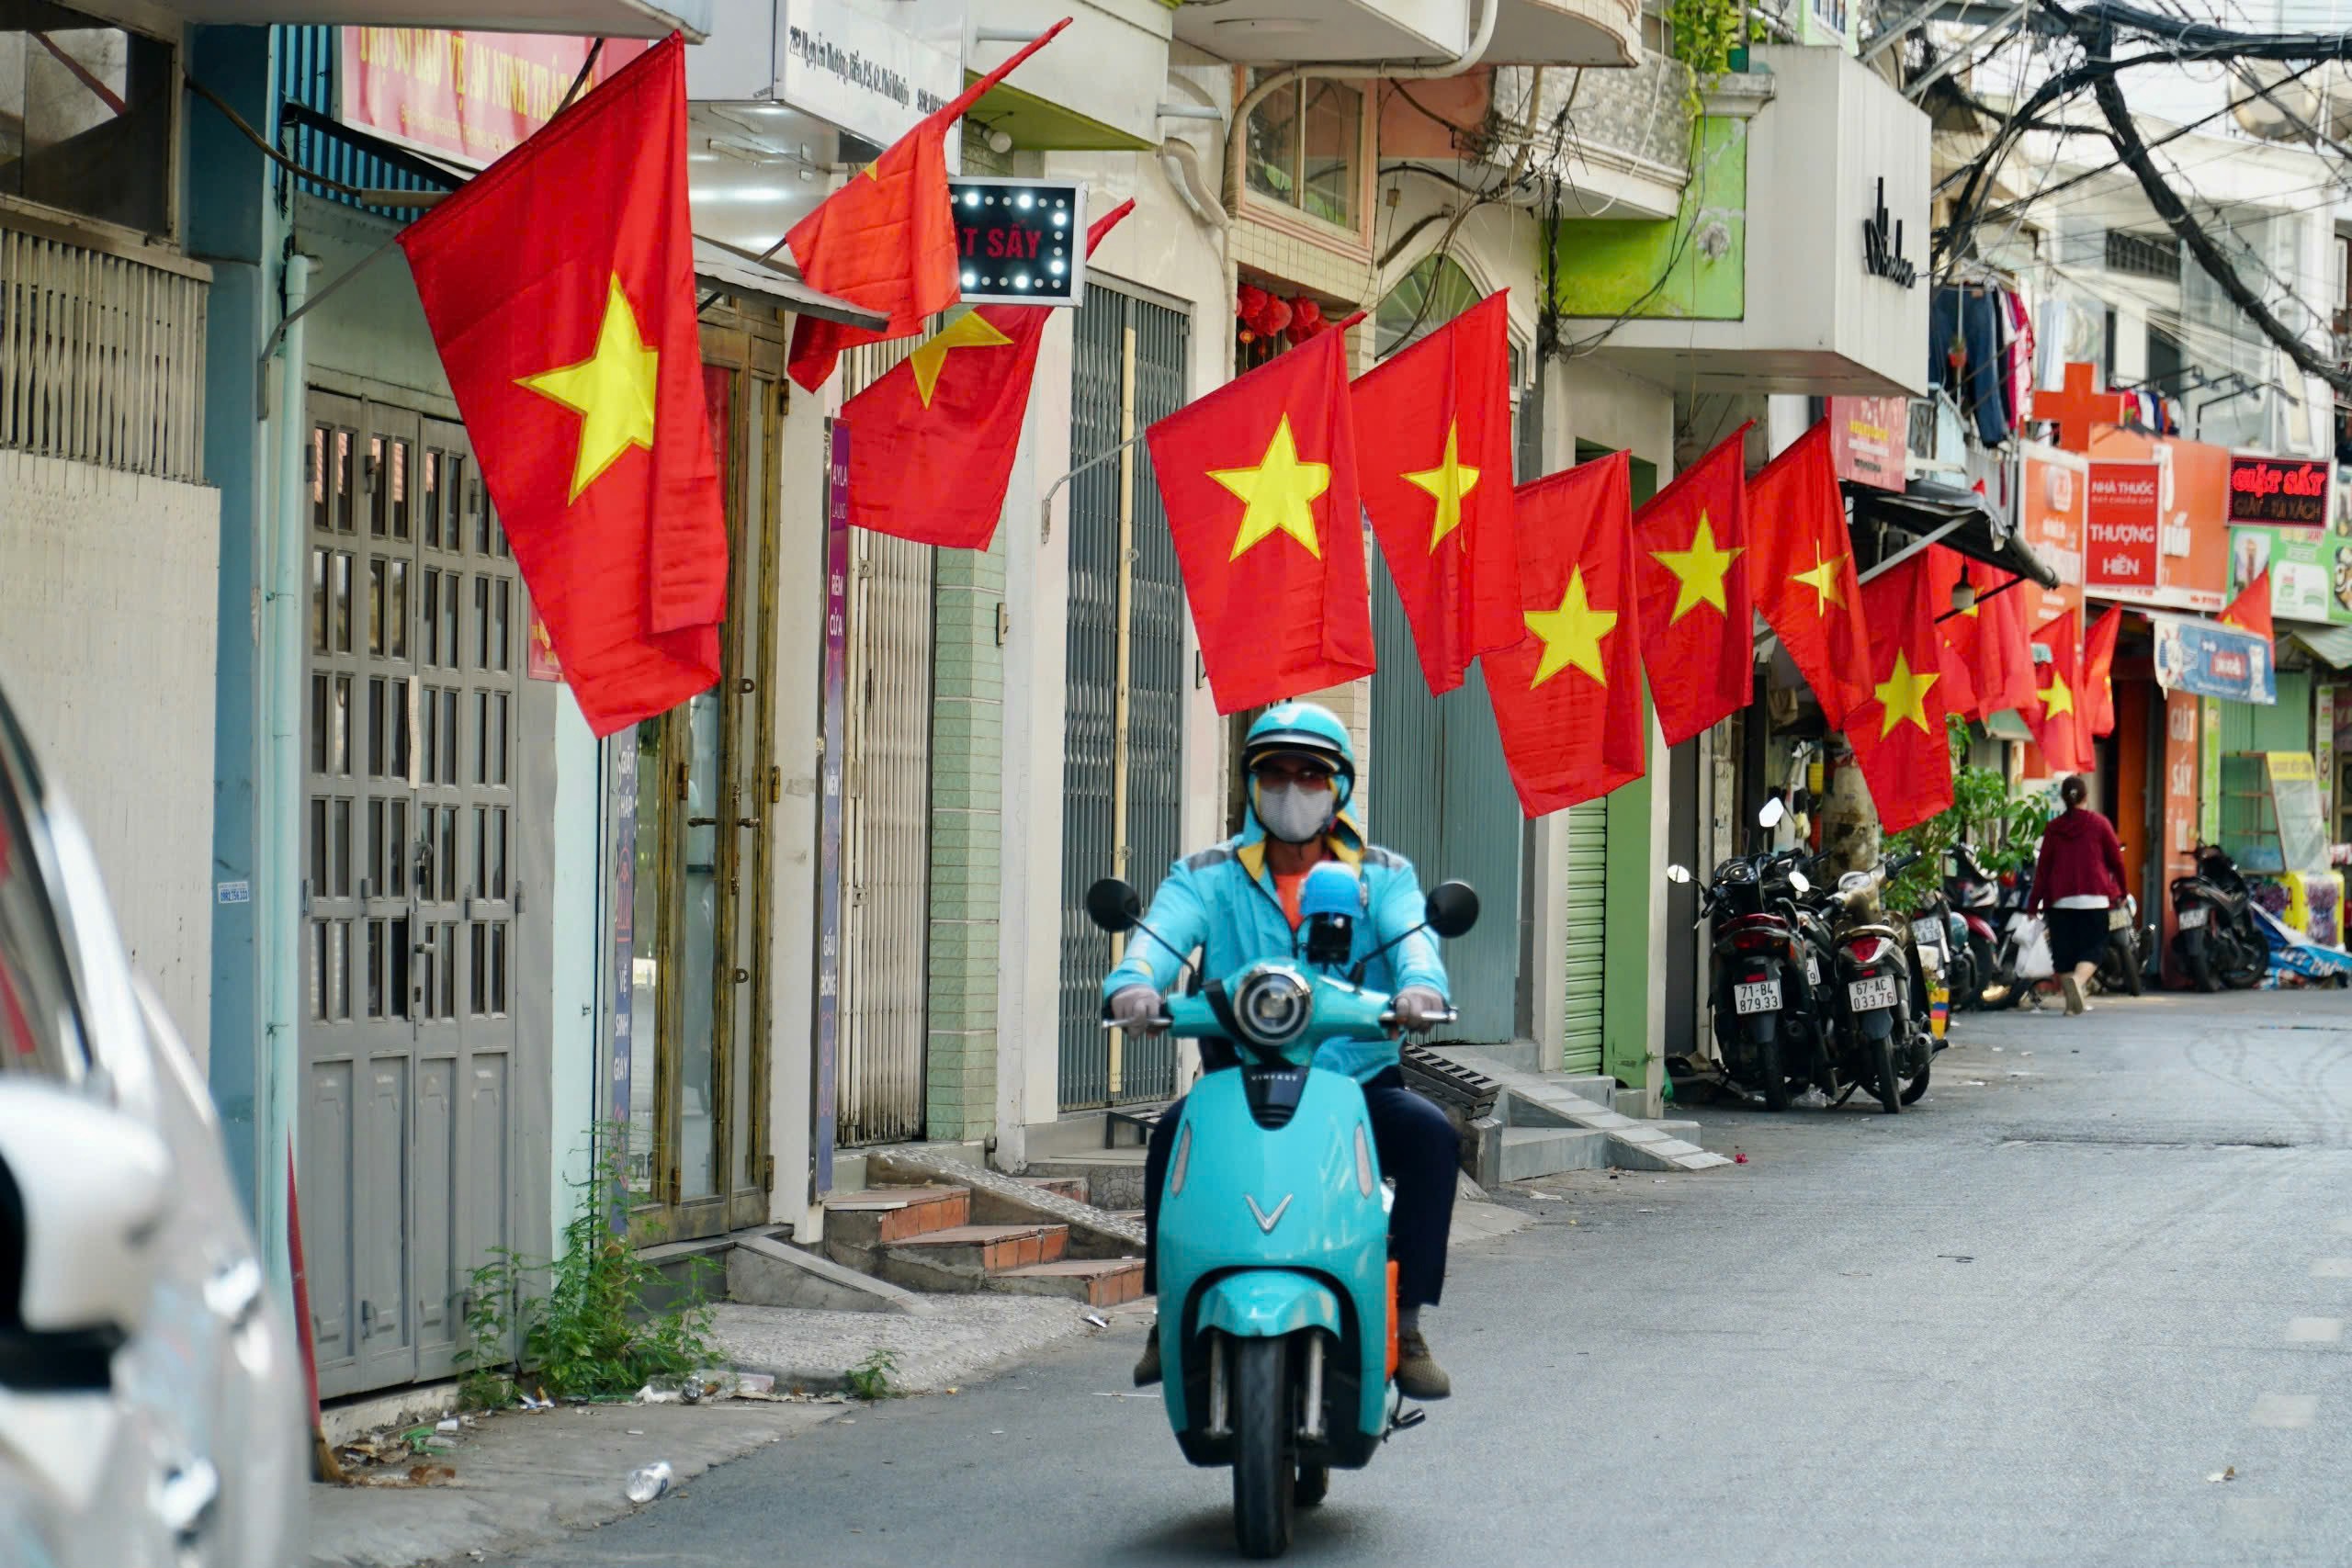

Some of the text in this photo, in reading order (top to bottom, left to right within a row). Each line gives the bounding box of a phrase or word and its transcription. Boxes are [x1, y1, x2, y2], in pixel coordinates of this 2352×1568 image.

[987, 220, 1042, 259] SẤY
[831, 463, 847, 487] AYLA
[2091, 479, 2154, 495] NHÀ THUỐC
[2089, 523, 2154, 546] THƯỢNG
[2102, 552, 2140, 576] HIỀN
[831, 569, 843, 596] RÈM
[830, 606, 842, 637] CỬA
[823, 927, 836, 956] GẤU
[1741, 984, 1773, 998] 71-B4
[1856, 979, 1887, 995] 67-AC
[1739, 996, 1778, 1011] 879.33
[1854, 992, 1894, 1010] 033.76
[615, 1014, 628, 1037] SINH
